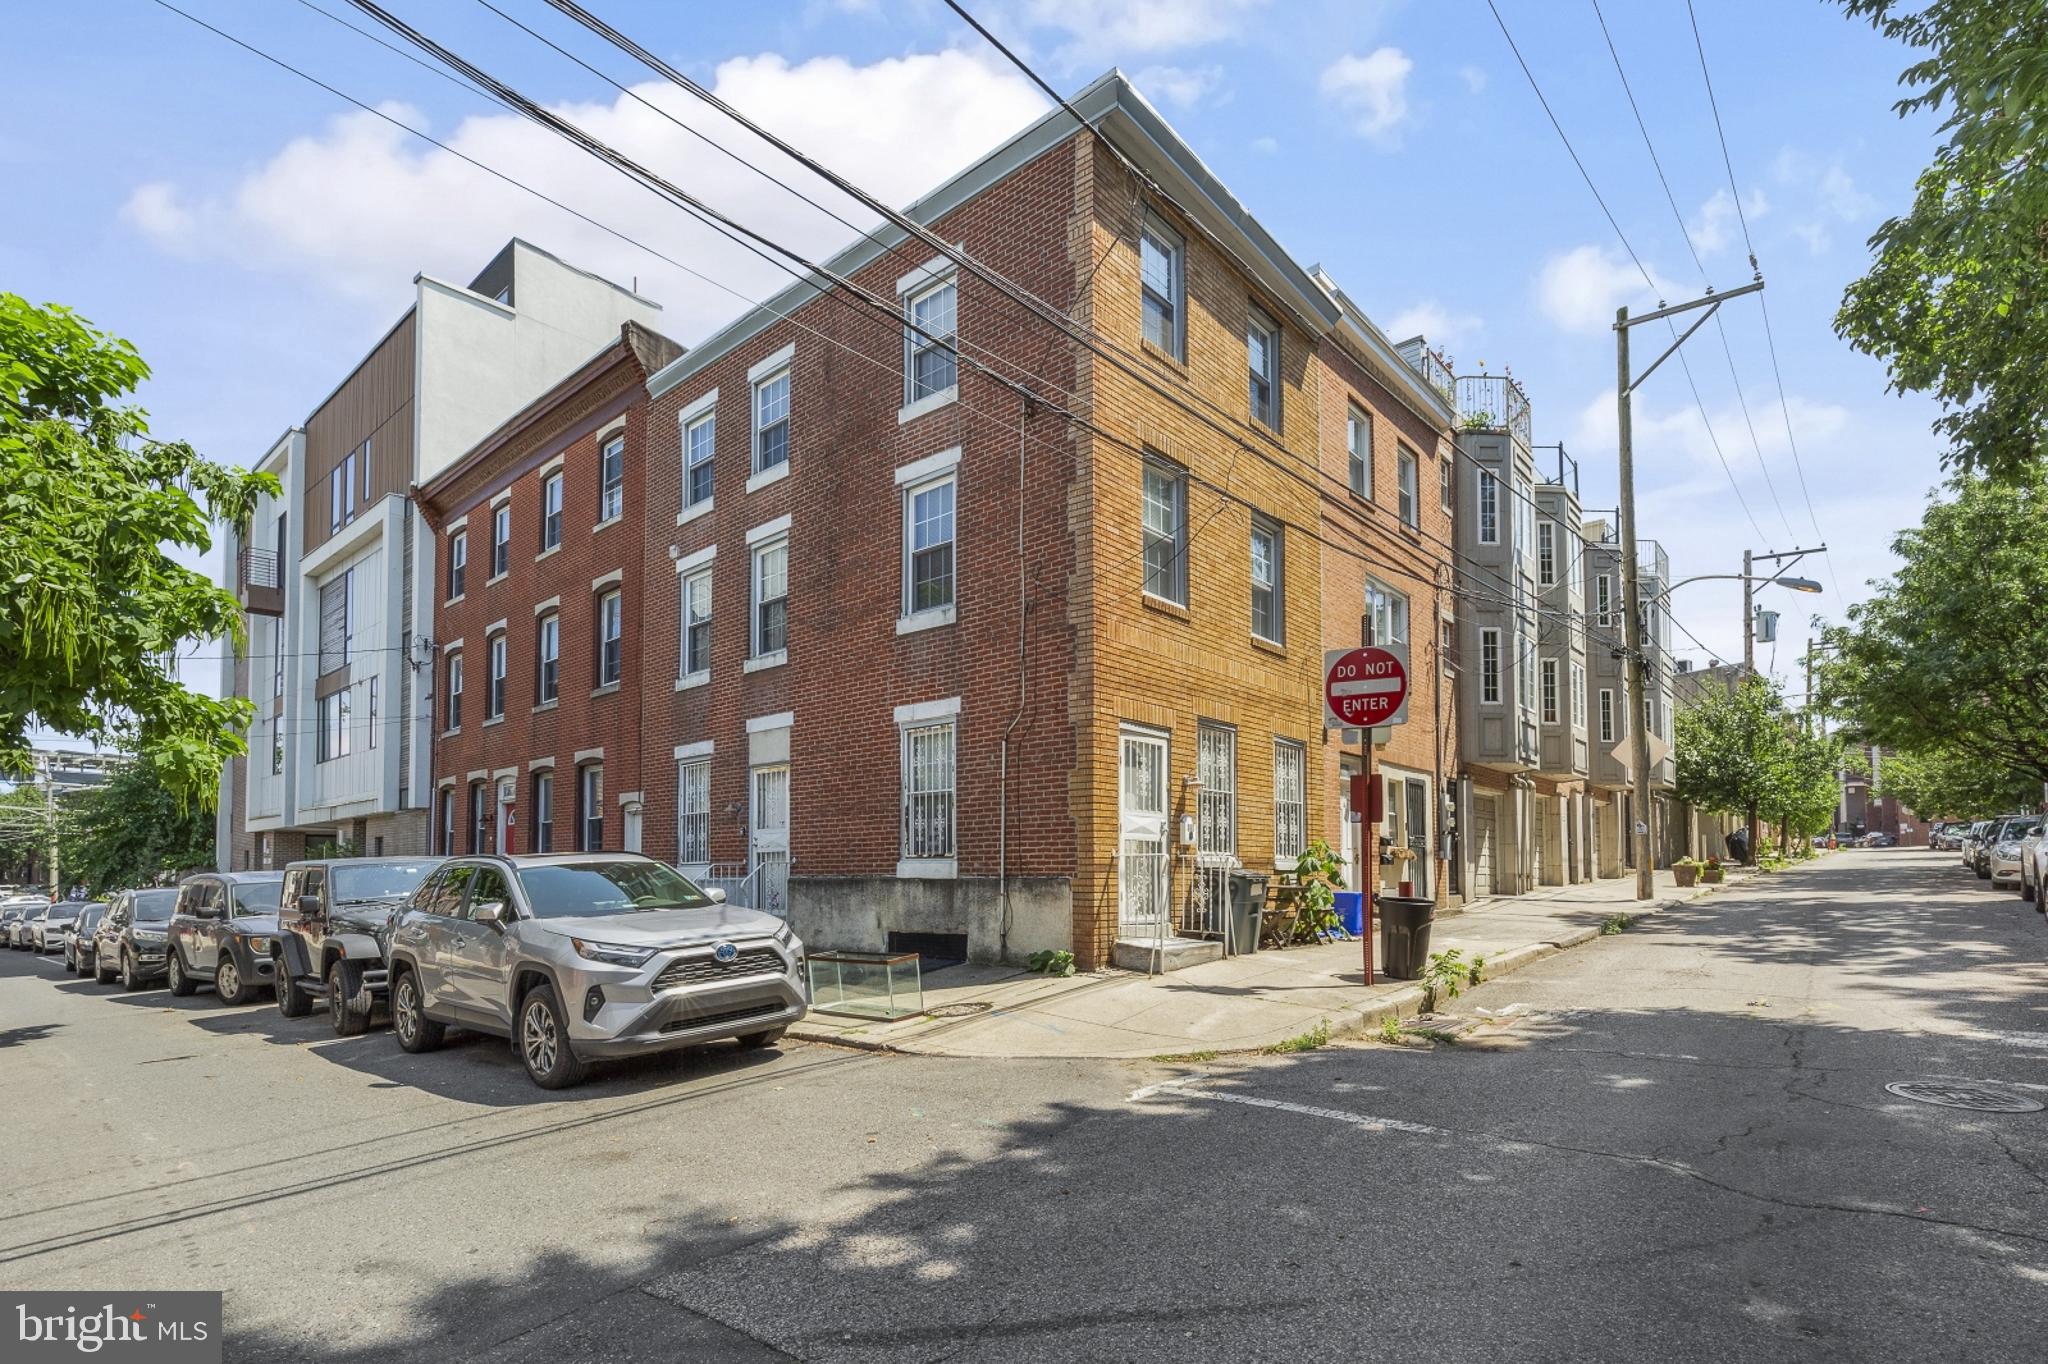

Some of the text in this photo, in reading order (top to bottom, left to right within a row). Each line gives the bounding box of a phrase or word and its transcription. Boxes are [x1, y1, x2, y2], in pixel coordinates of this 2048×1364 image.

[1337, 661, 1394, 678] DO NOT
[1343, 697, 1388, 712] ENTER
